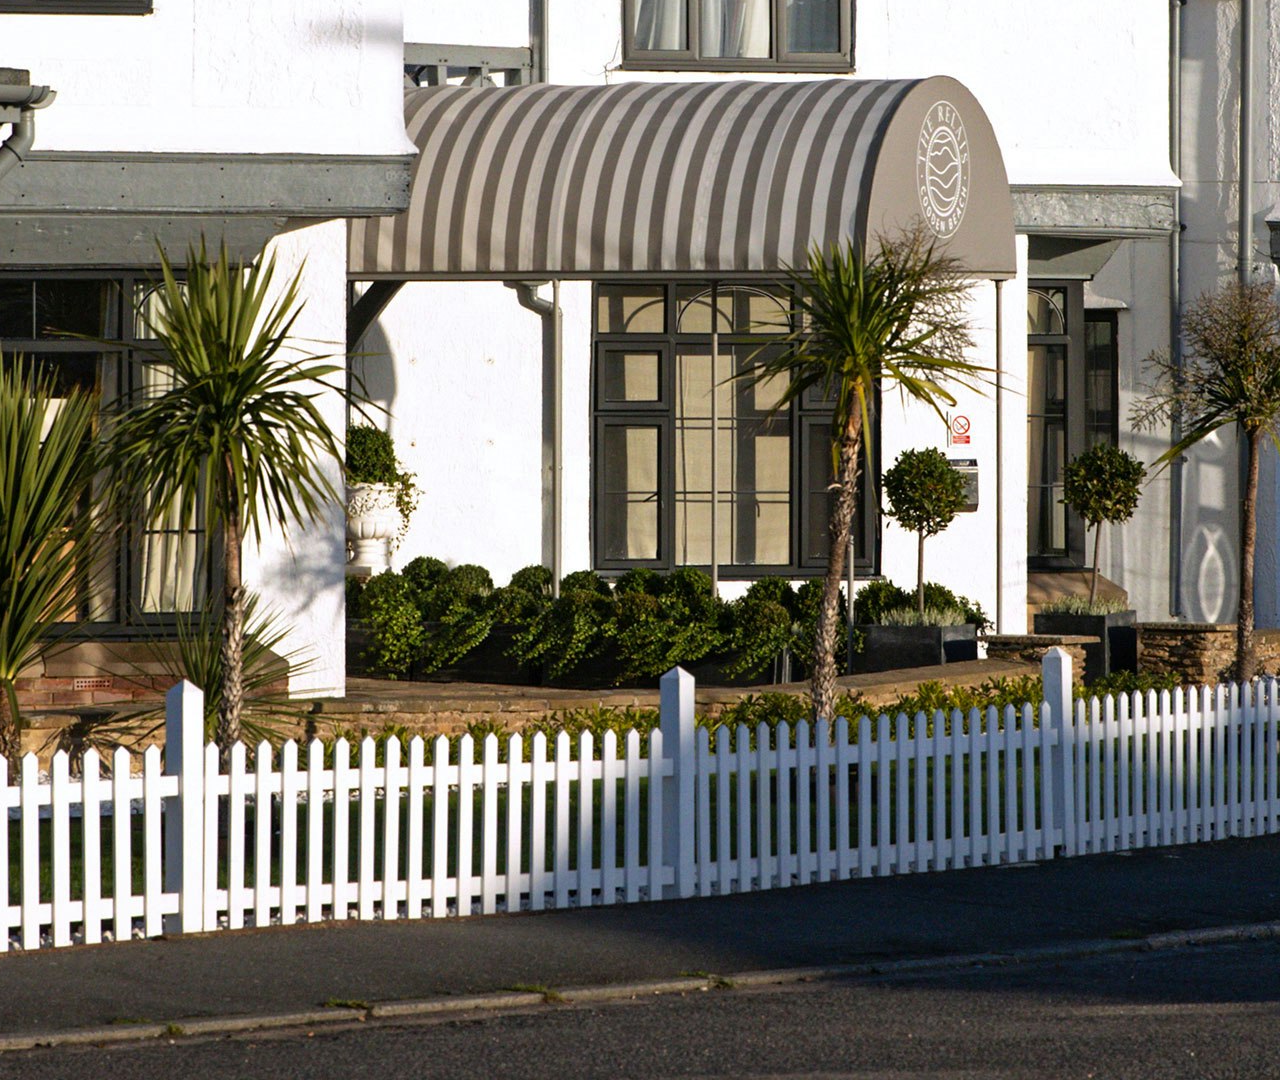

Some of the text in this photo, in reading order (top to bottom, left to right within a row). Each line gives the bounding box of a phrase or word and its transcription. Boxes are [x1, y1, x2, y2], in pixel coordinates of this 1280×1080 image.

[918, 105, 969, 164] THE RELAIS
[920, 185, 968, 232] COODEN BEACH
